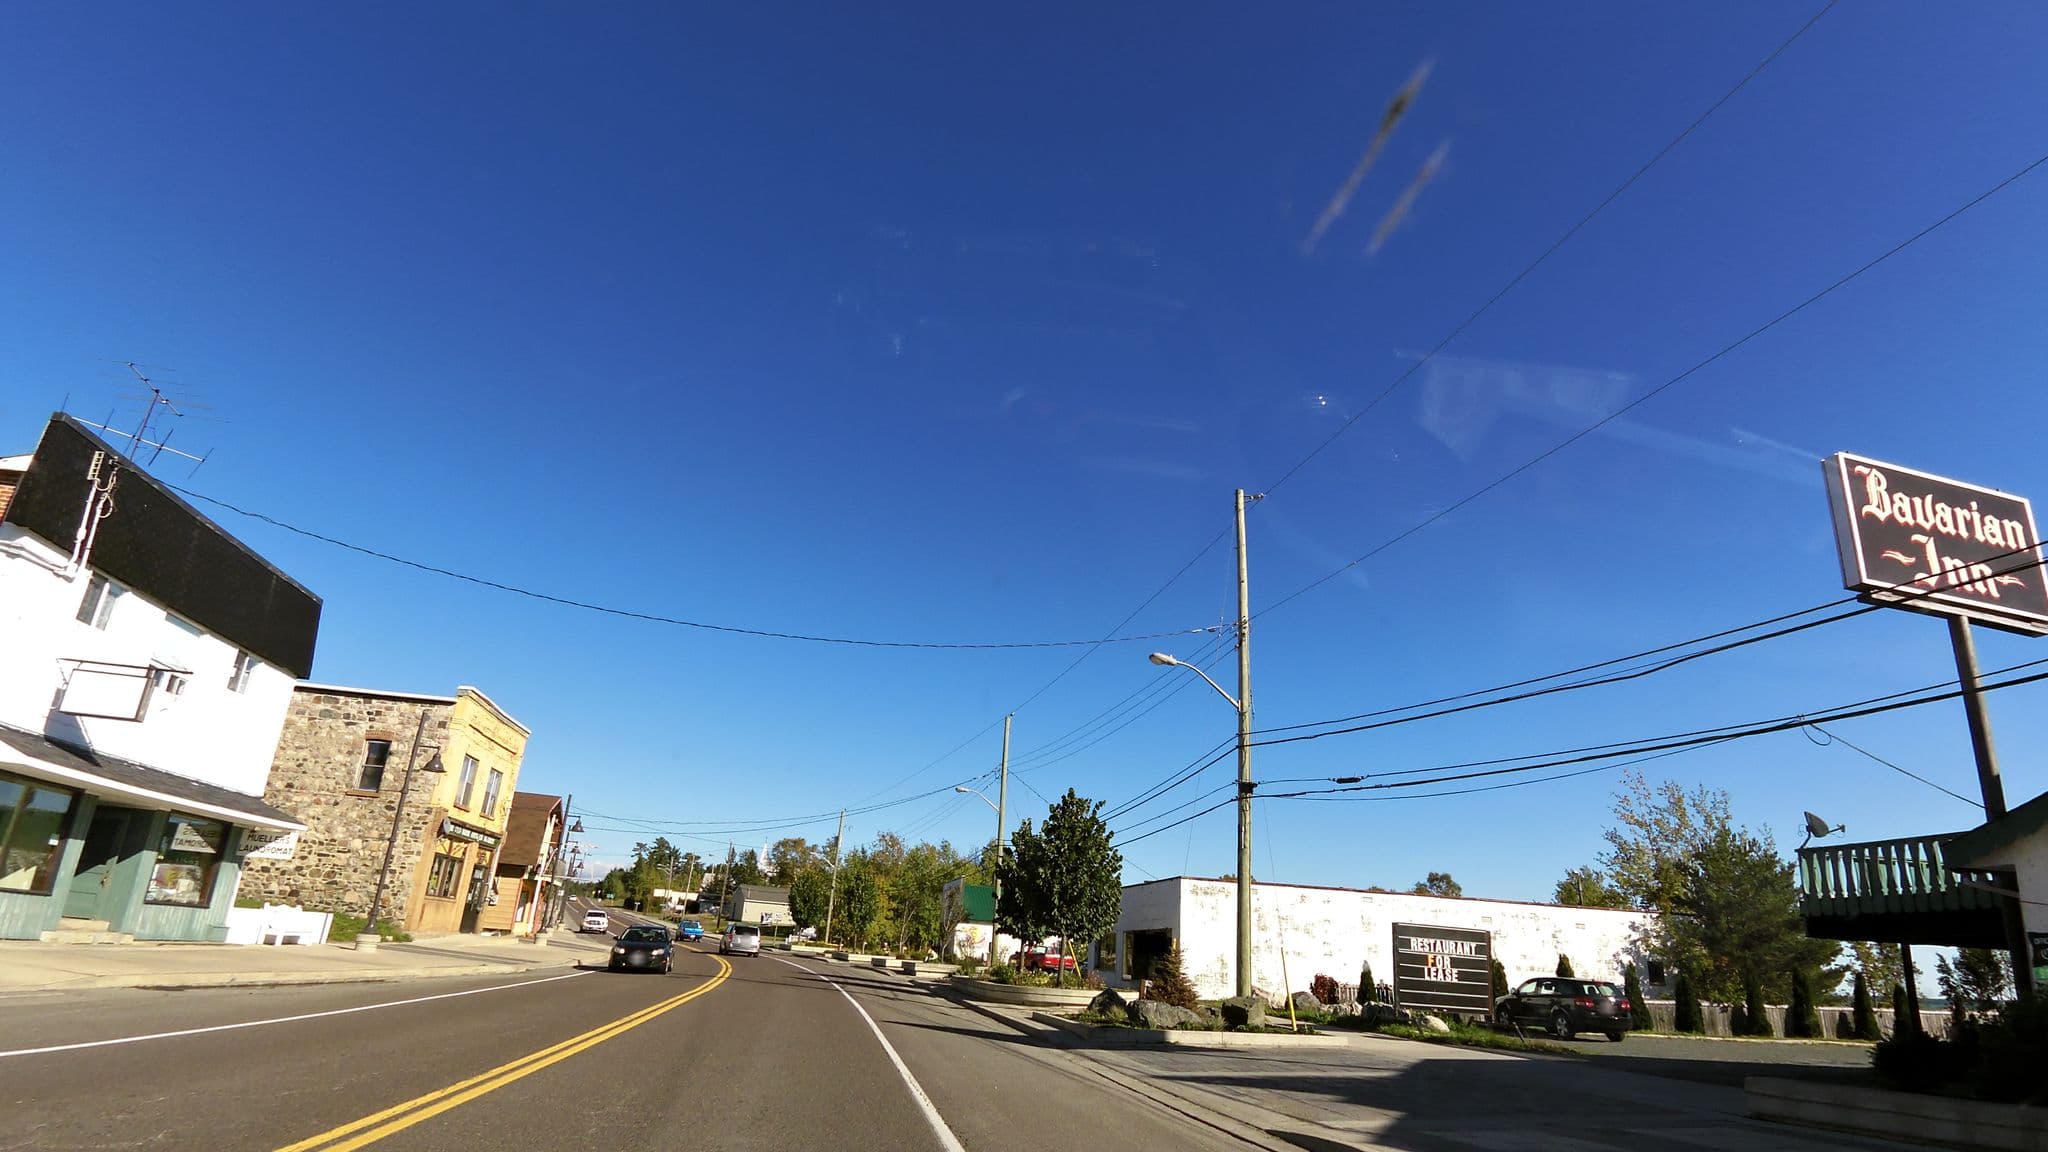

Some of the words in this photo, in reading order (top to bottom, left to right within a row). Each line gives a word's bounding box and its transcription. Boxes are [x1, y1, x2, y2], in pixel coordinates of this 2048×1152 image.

[1854, 465, 2029, 553] Bavarian
[1910, 533, 2000, 599] Inn
[1410, 937, 1477, 956] RESTAURANT
[1427, 954, 1451, 969] FOR
[1424, 967, 1459, 982] LEASE
